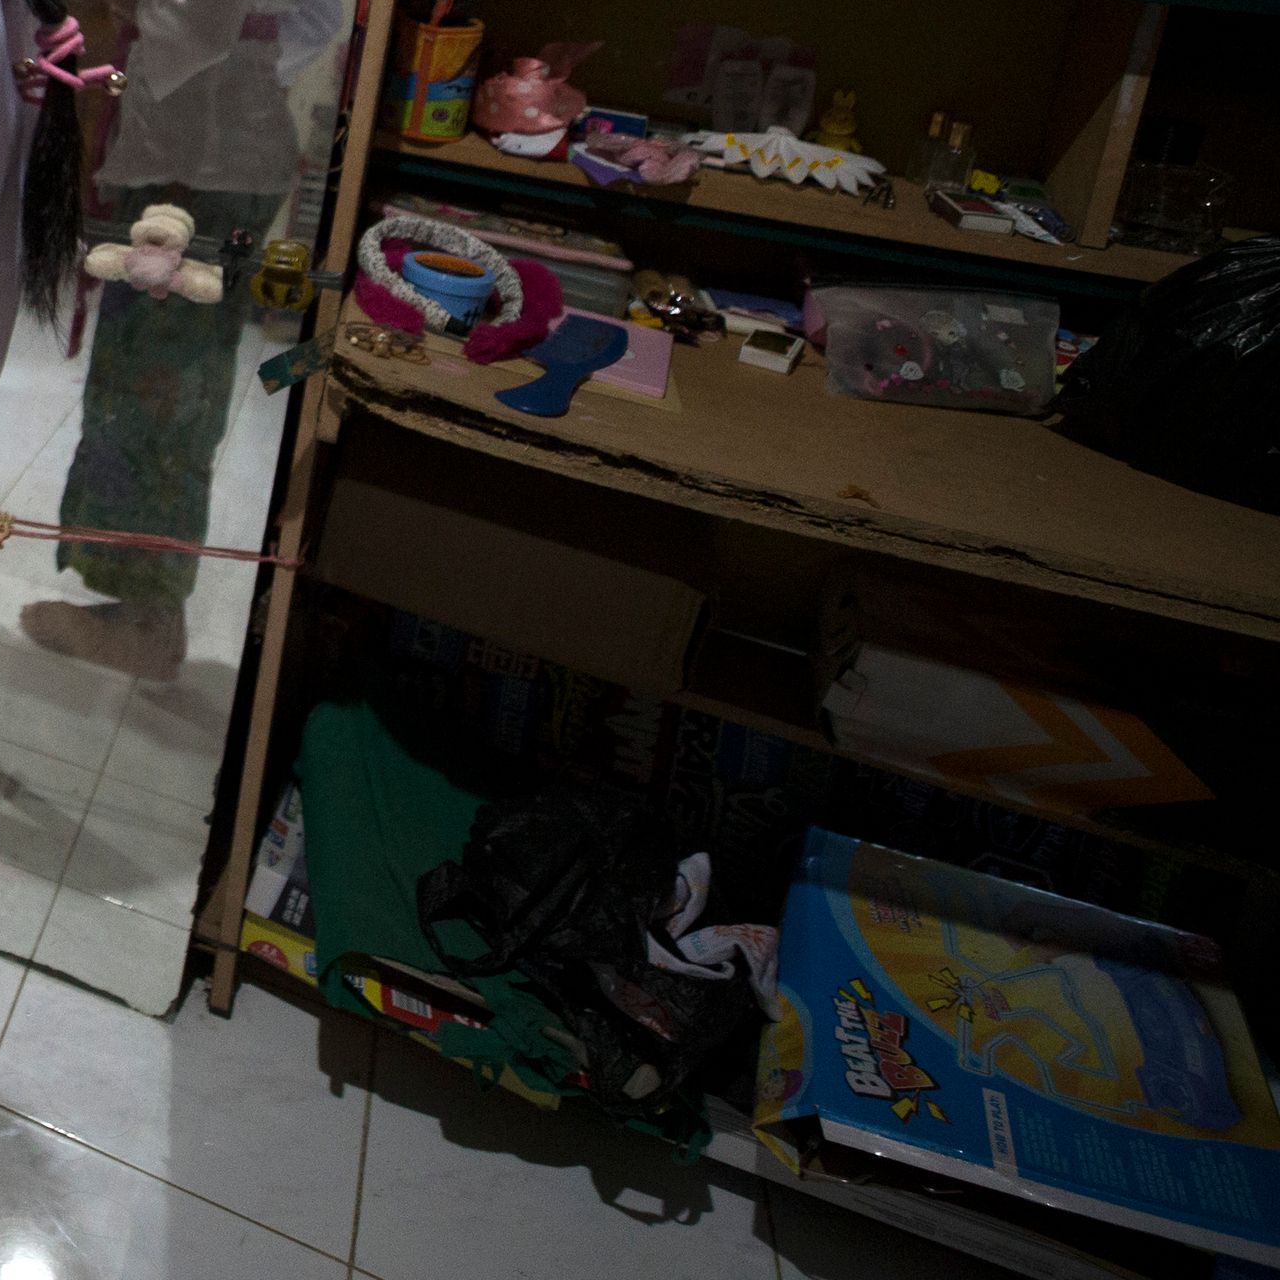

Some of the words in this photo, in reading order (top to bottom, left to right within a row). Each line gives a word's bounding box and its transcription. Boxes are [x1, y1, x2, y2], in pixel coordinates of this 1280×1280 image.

[833, 995, 865, 1031] THE
[867, 1008, 937, 1090] BUZZ
[834, 1023, 893, 1096] BEAT
